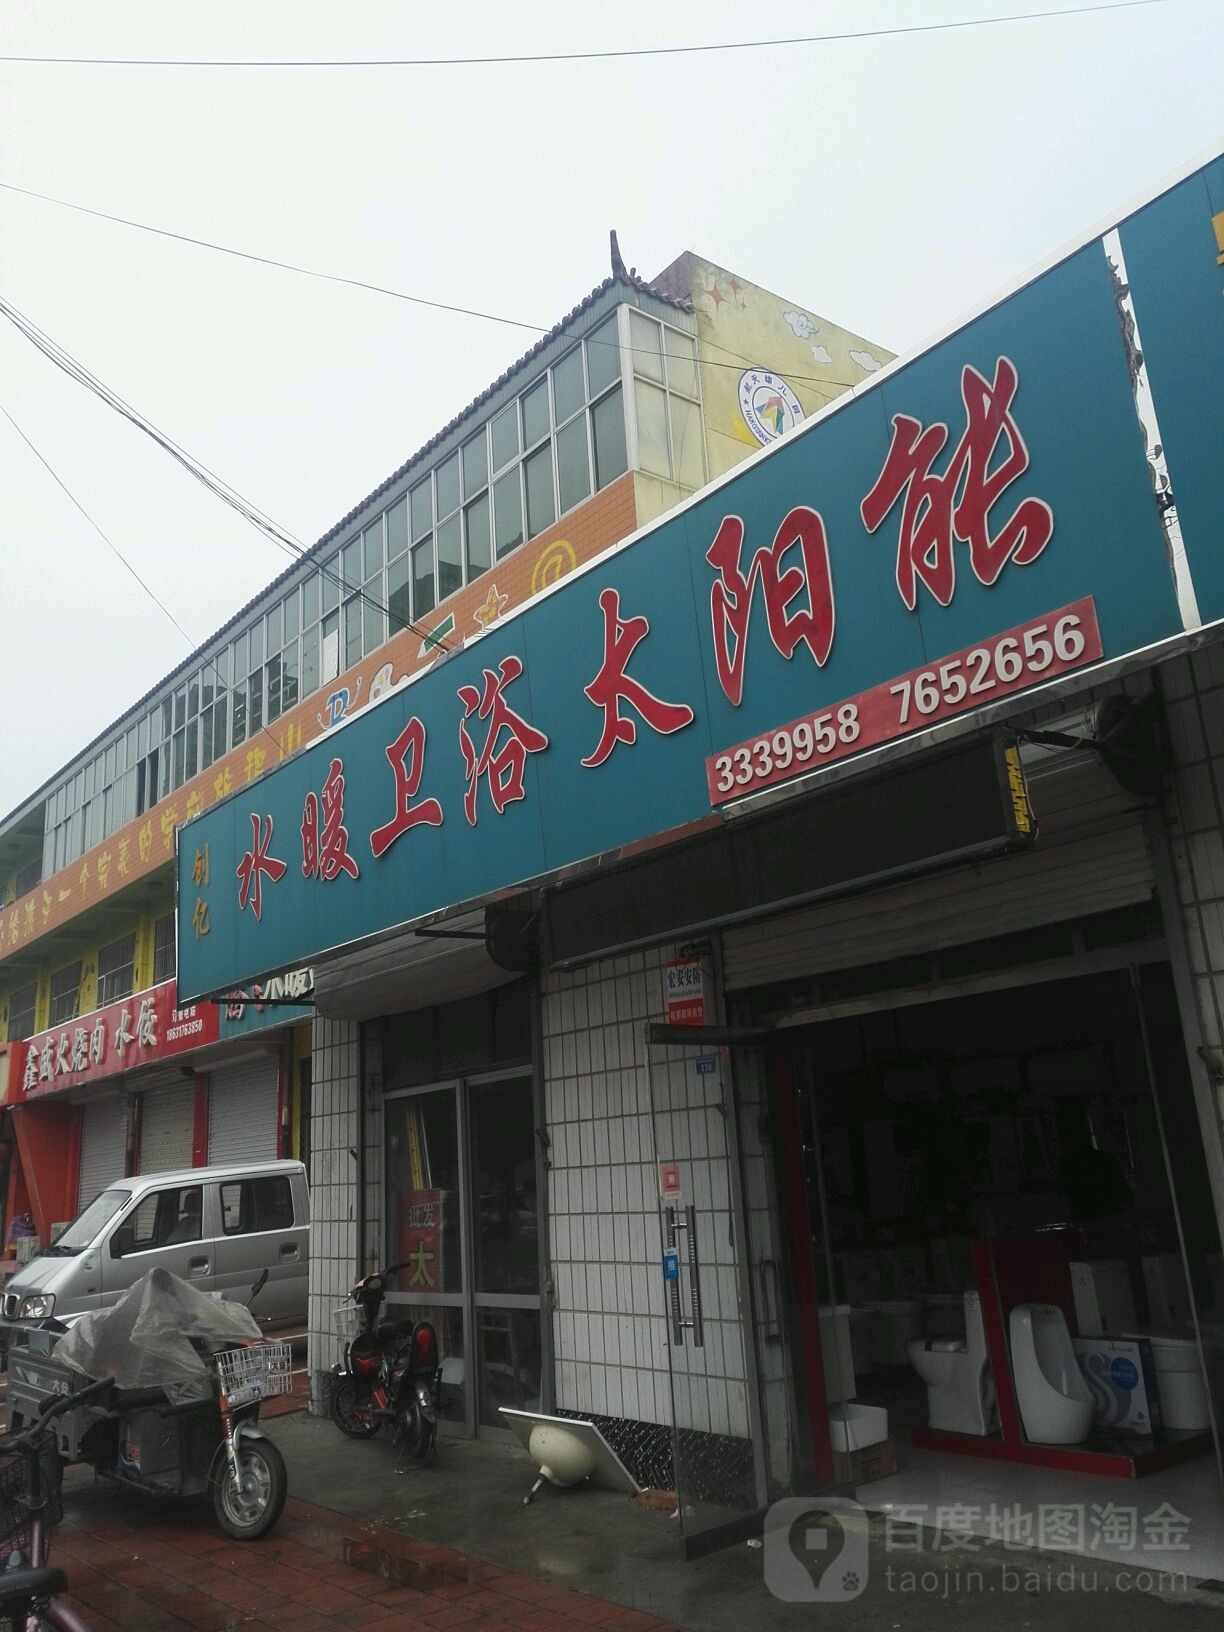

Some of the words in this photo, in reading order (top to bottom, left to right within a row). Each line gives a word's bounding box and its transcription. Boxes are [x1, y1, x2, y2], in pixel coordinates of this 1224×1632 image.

[236, 356, 1054, 922] 水暖卫浴太阳能
[715, 703, 860, 792] 3339958
[890, 613, 1086, 724] 7652656
[408, 1203, 435, 1228] 批发
[408, 1240, 435, 1288] 太
